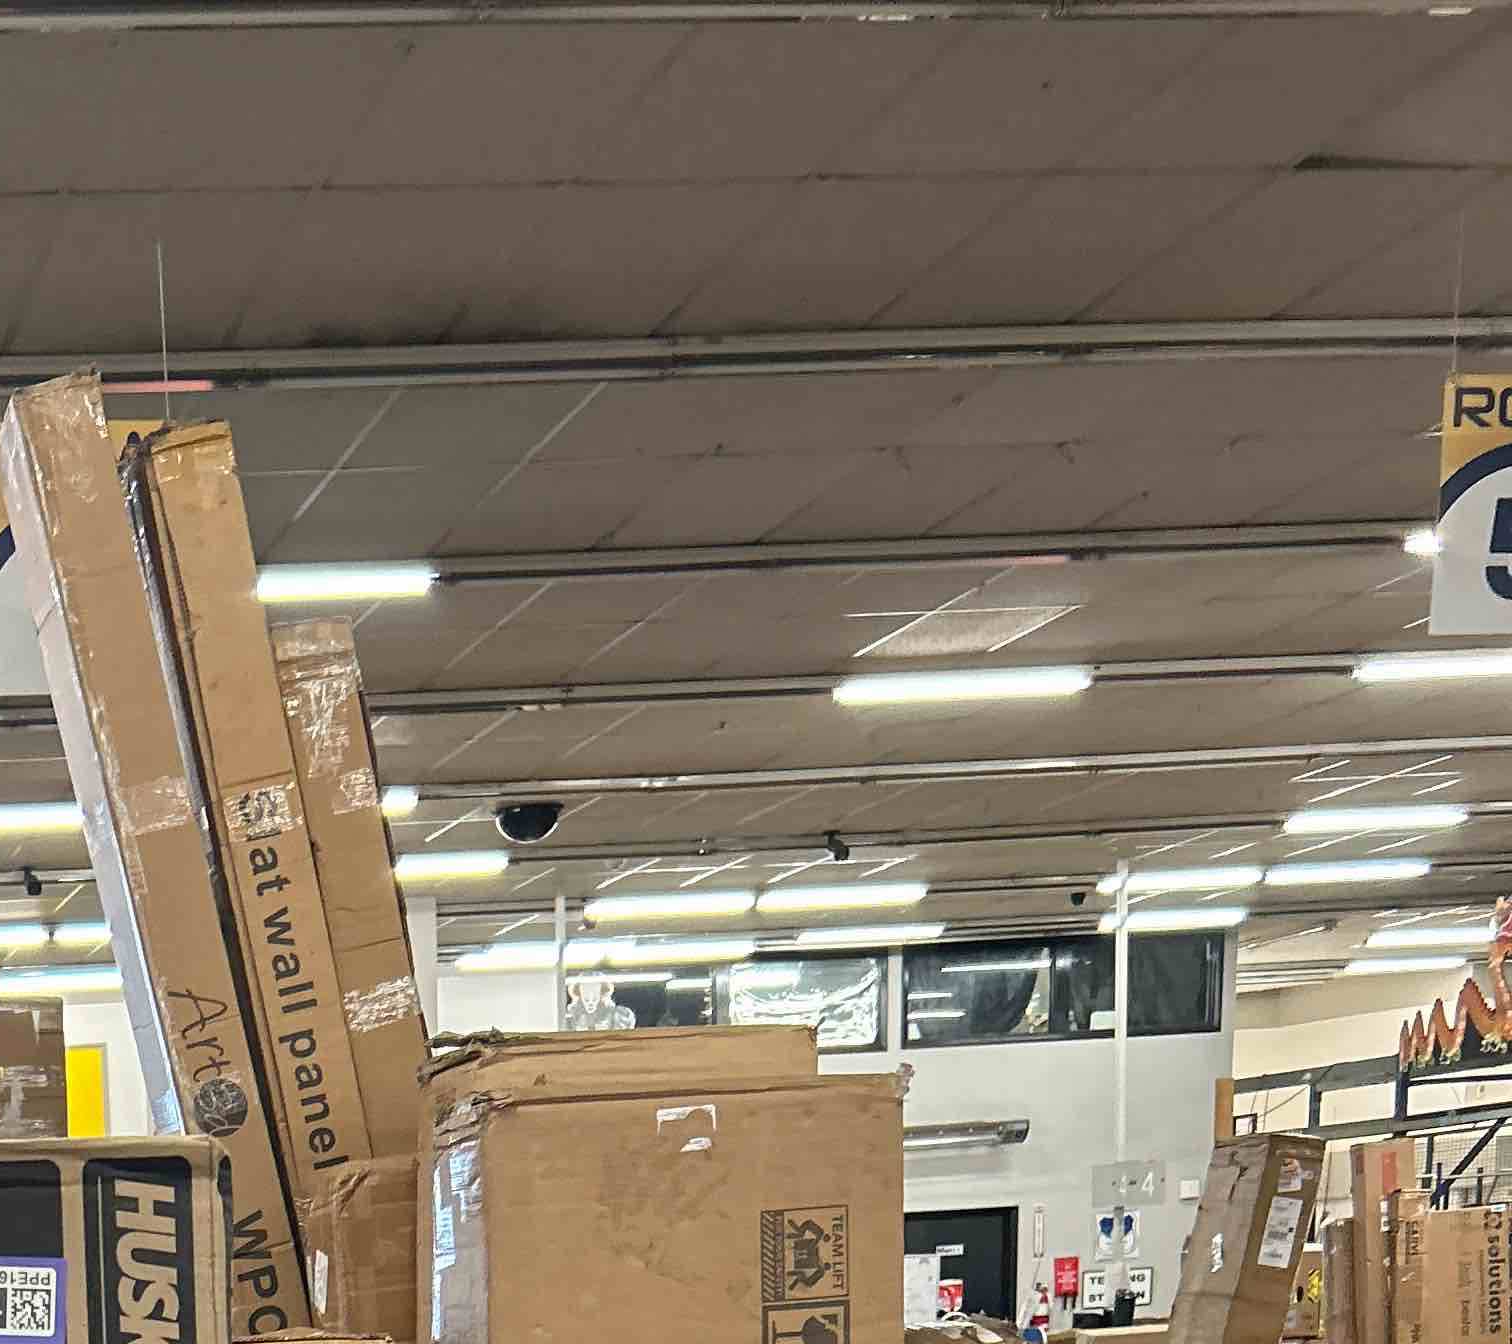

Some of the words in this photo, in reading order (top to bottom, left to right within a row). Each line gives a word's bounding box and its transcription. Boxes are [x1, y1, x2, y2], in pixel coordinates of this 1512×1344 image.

[263, 907, 318, 1014] wall
[279, 1029, 349, 1170] panel
[232, 1210, 288, 1336] WPC
[831, 1215, 845, 1257] TEAM
[831, 1263, 845, 1291] LIFT
[1089, 1273, 1146, 1286] TENG
[1487, 1235, 1506, 1335] solutions
